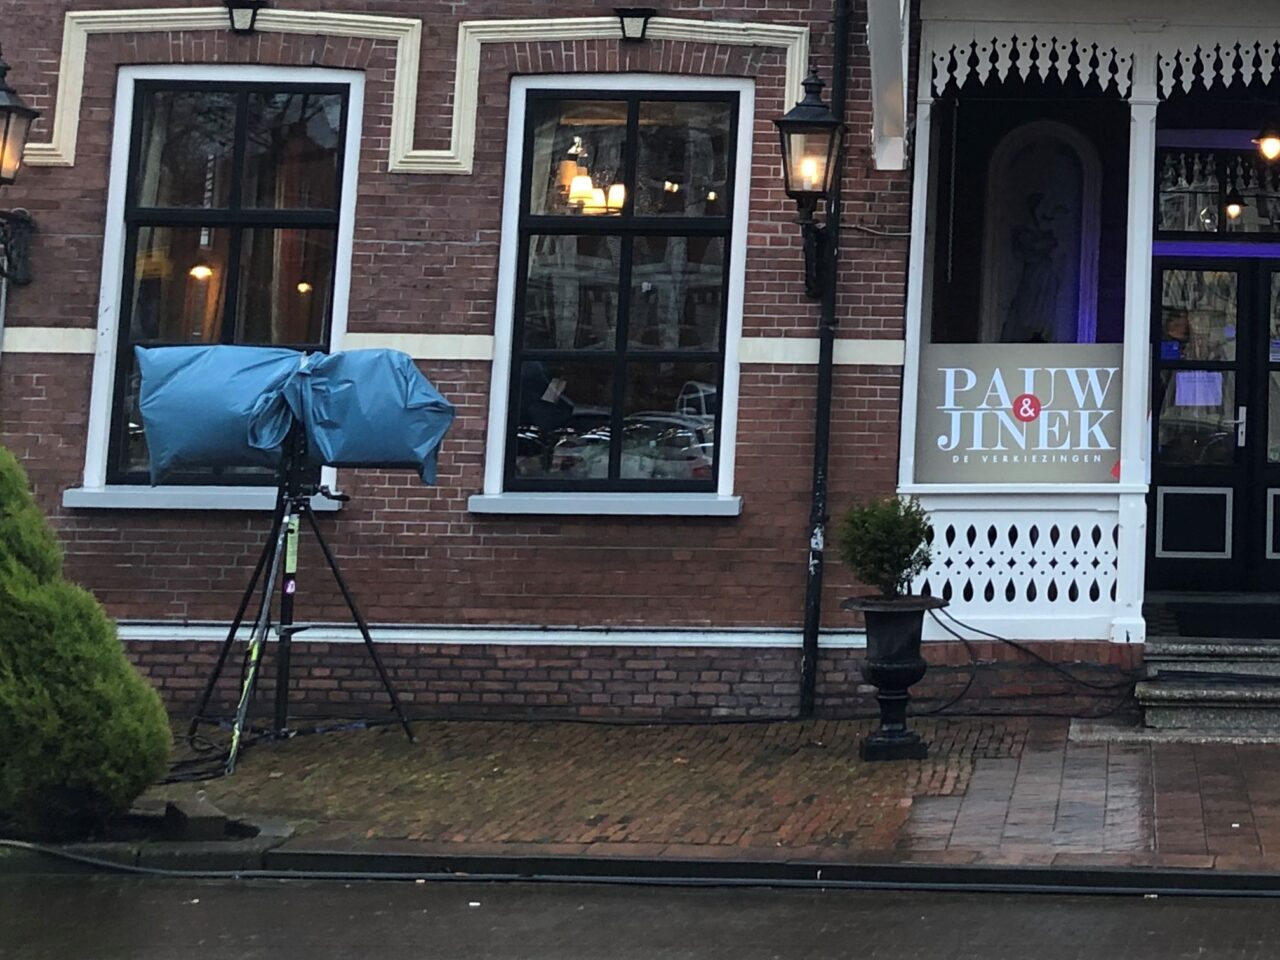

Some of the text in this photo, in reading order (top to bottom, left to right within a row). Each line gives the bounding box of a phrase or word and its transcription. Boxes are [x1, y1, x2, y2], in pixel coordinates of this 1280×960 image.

[936, 367, 1119, 409] PAUW
[1019, 397, 1035, 417] &
[937, 410, 1116, 451] JINEK
[952, 455, 1102, 463] DE VERKIEZINGEN
